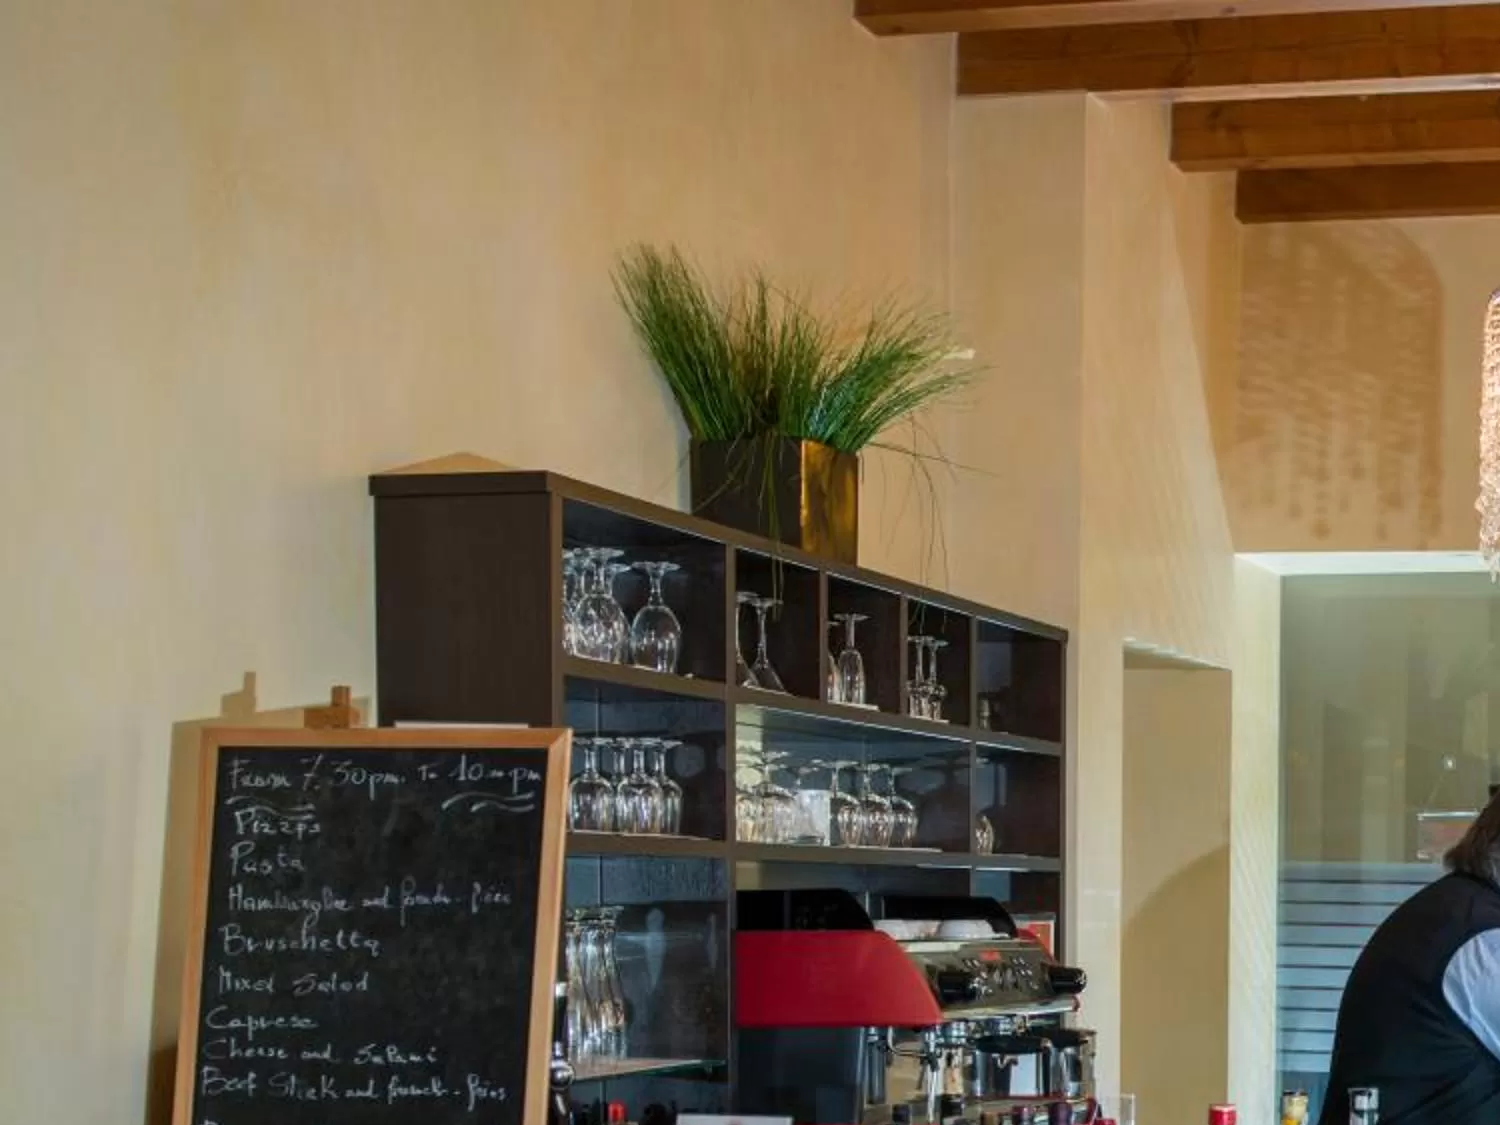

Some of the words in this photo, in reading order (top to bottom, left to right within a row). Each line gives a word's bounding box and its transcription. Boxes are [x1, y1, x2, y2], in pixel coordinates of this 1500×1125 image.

[231, 841, 304, 876] Pasta
[218, 923, 379, 957] Bruschetta
[219, 965, 275, 994] Mixed
[205, 1006, 319, 1040] Caprese
[204, 1037, 288, 1060] Cheese
[302, 1043, 341, 1063] and
[201, 1065, 256, 1097] Beef
